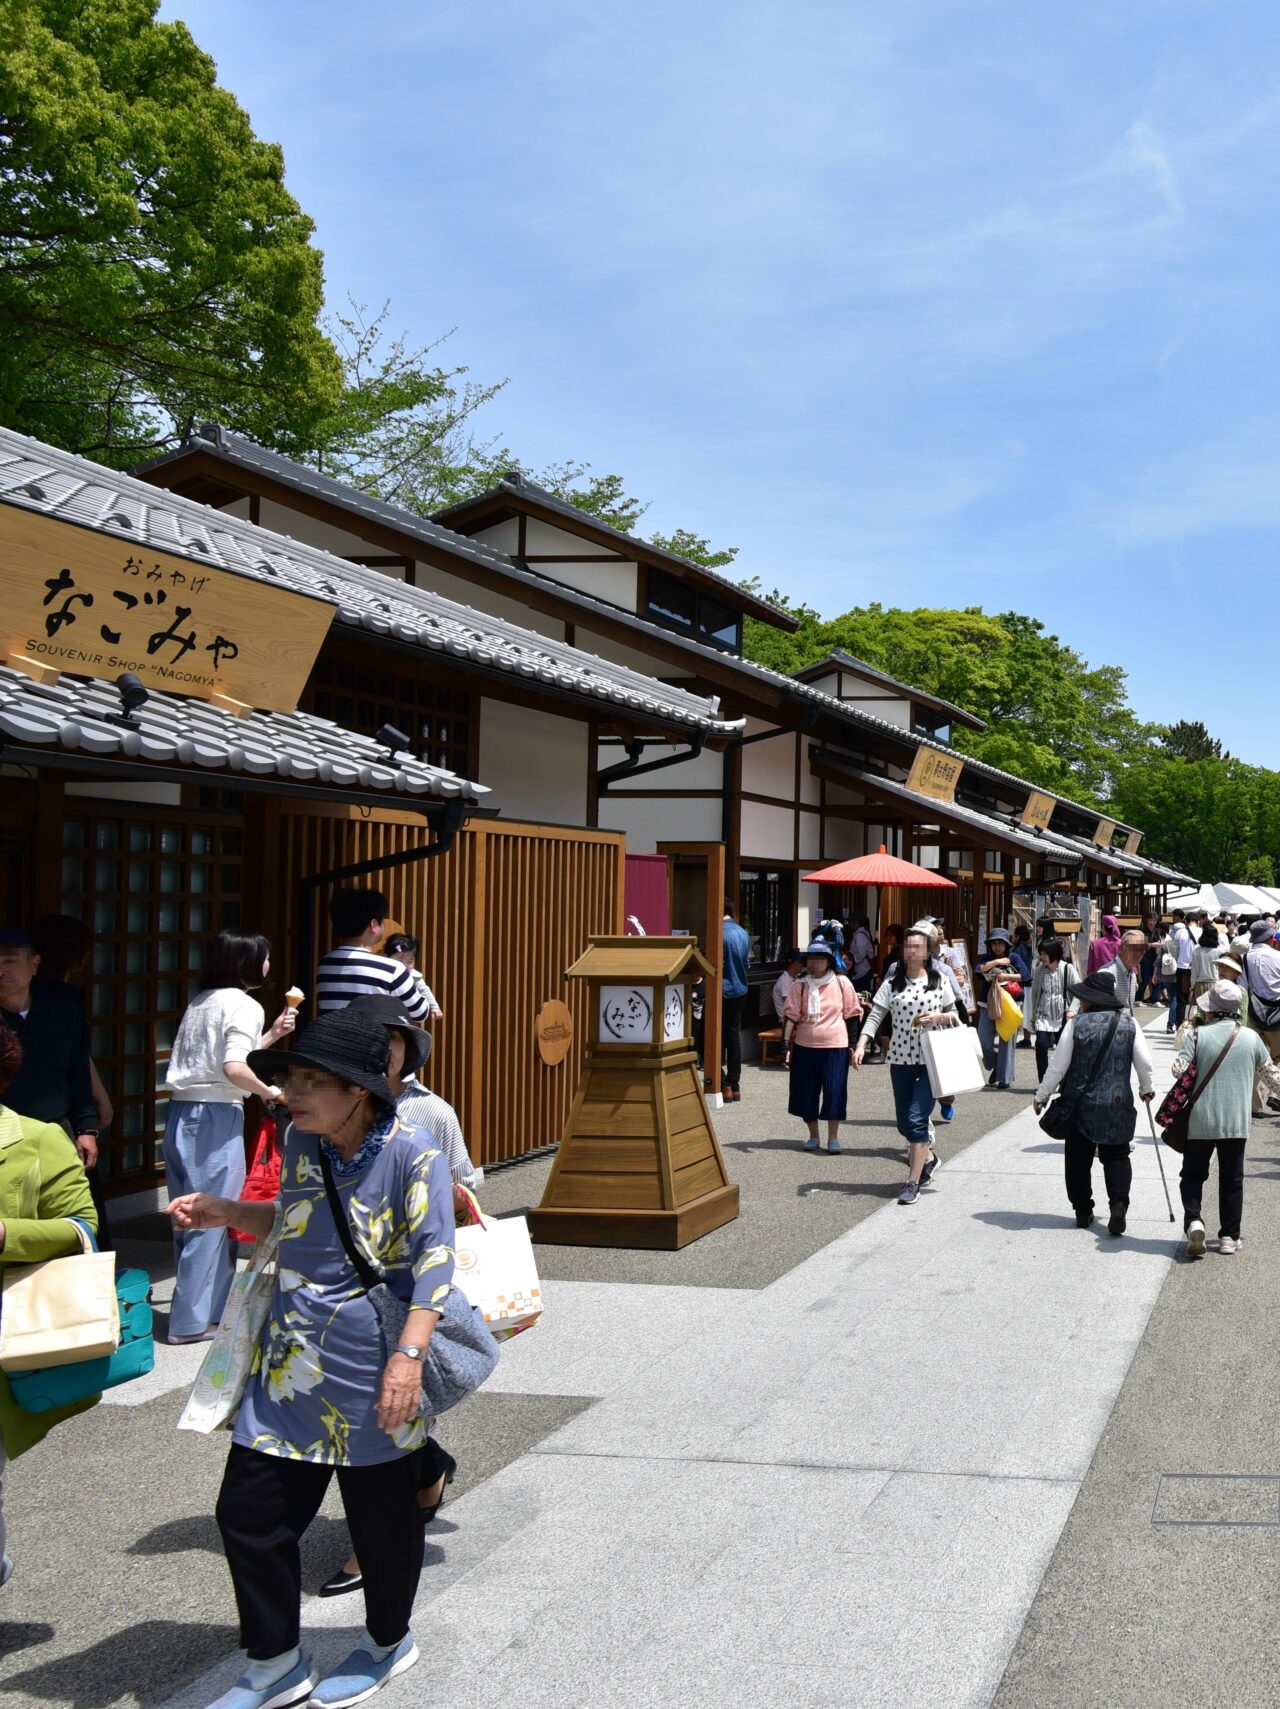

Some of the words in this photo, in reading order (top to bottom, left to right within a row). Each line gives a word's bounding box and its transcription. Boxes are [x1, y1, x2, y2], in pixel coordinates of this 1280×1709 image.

[122, 556, 210, 594] おみやげ
[43, 569, 238, 672] なごみや
[25, 639, 103, 664] SOUVENIR
[108, 656, 146, 672] SHOP
